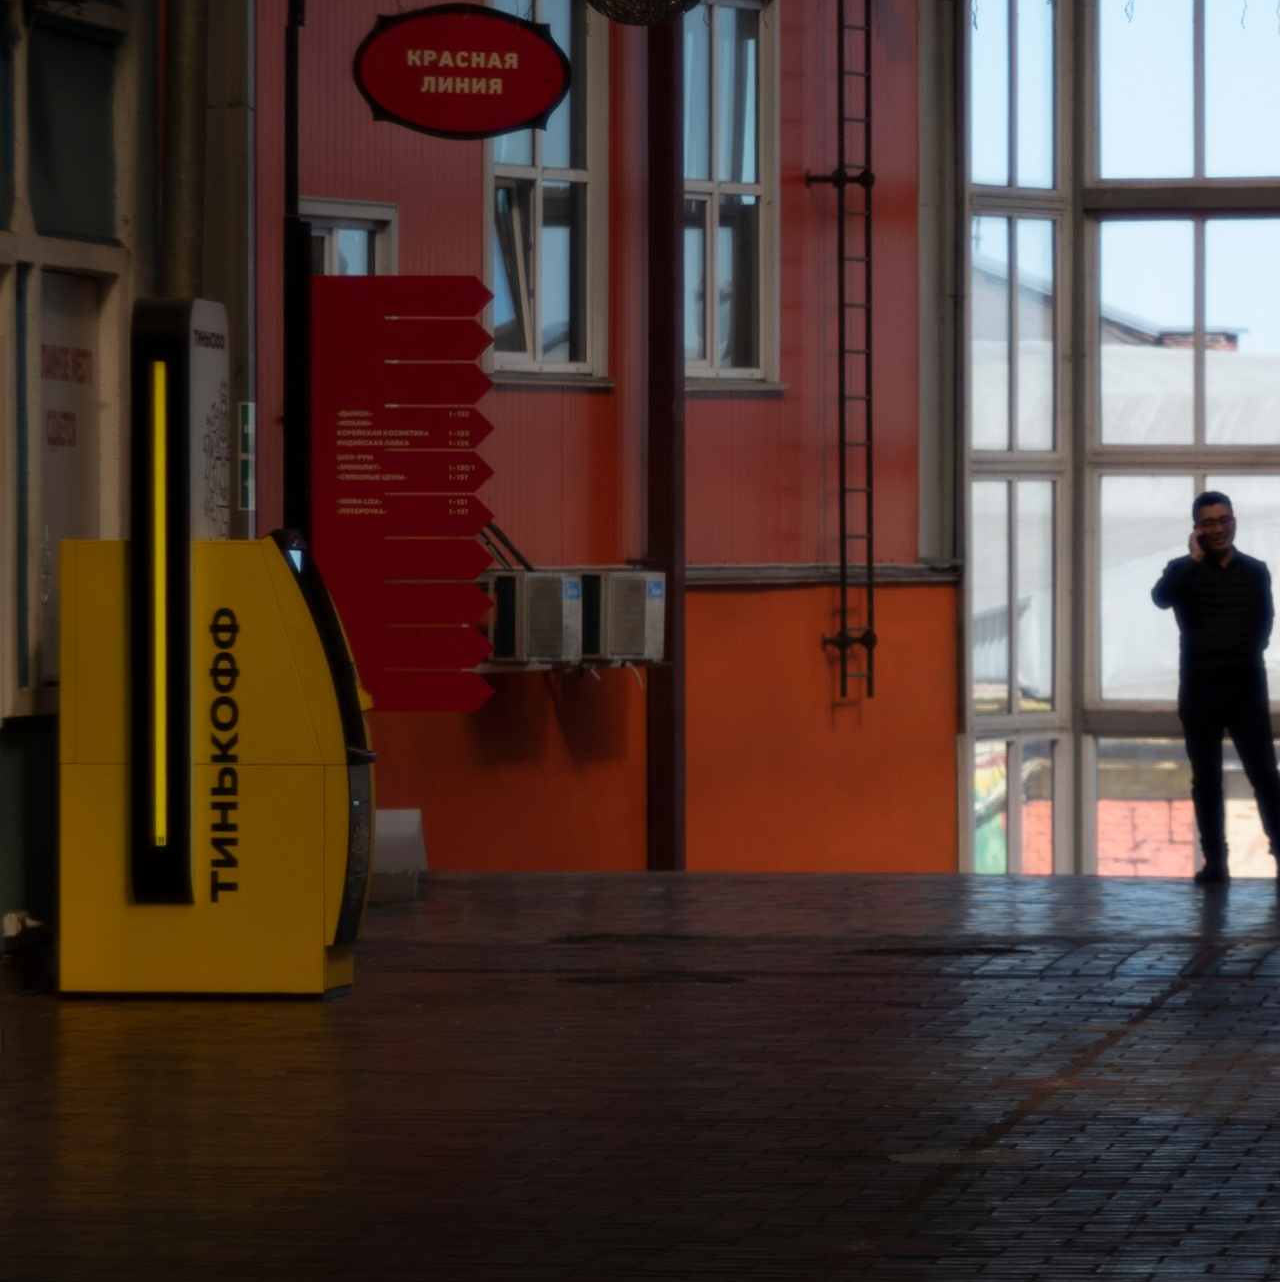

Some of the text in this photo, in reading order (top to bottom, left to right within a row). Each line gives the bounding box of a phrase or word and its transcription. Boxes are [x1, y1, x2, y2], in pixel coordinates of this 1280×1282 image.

[406, 48, 519, 70] КРАСНАЯ
[420, 75, 504, 96] ЛИНИЯ
[208, 605, 241, 903] ТИНЬКОФФ
